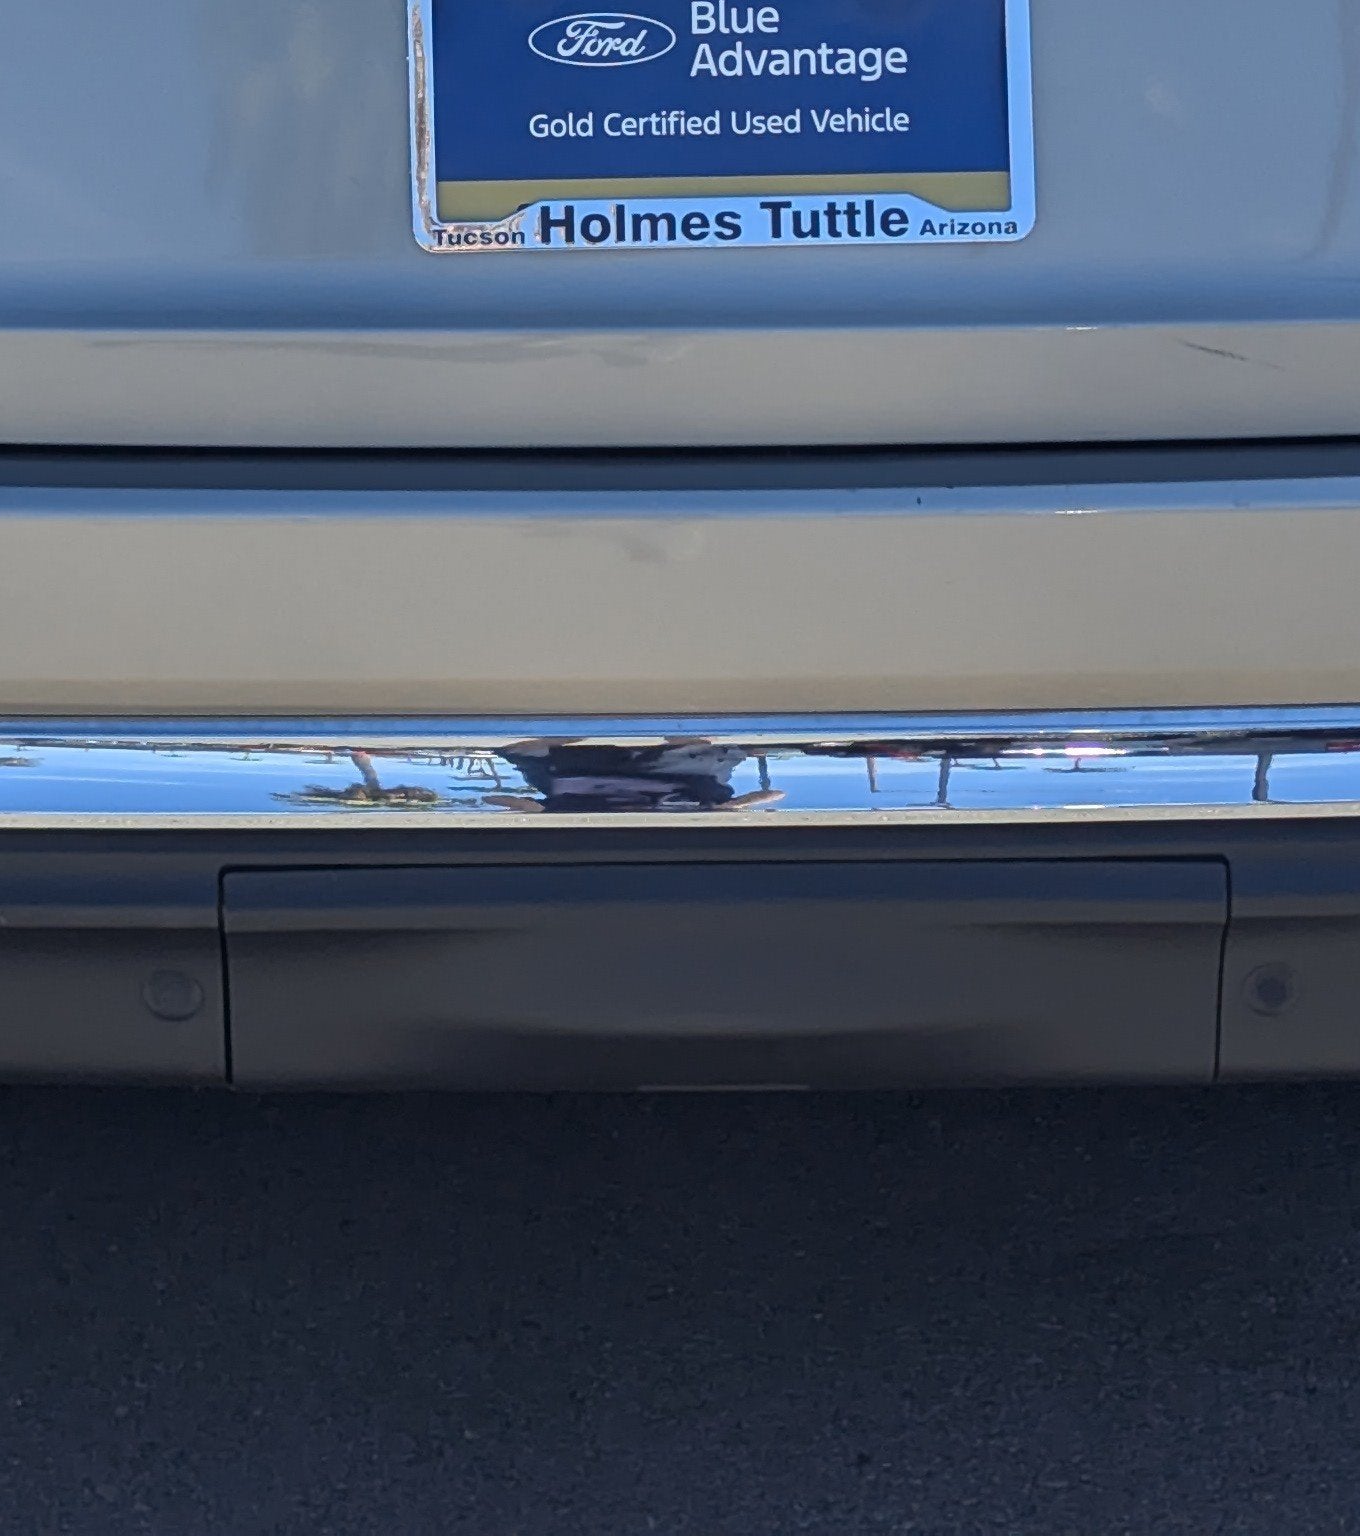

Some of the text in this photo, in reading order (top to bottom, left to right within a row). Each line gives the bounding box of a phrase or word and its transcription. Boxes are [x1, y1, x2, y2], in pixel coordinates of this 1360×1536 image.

[690, 0, 780, 35] Blue
[556, 20, 648, 58] Ford
[689, 41, 908, 82] Advantage
[529, 107, 910, 138] Gold Certified Used Vehicle
[434, 199, 1018, 246] Tucson Holmes Tuttle Arizona
